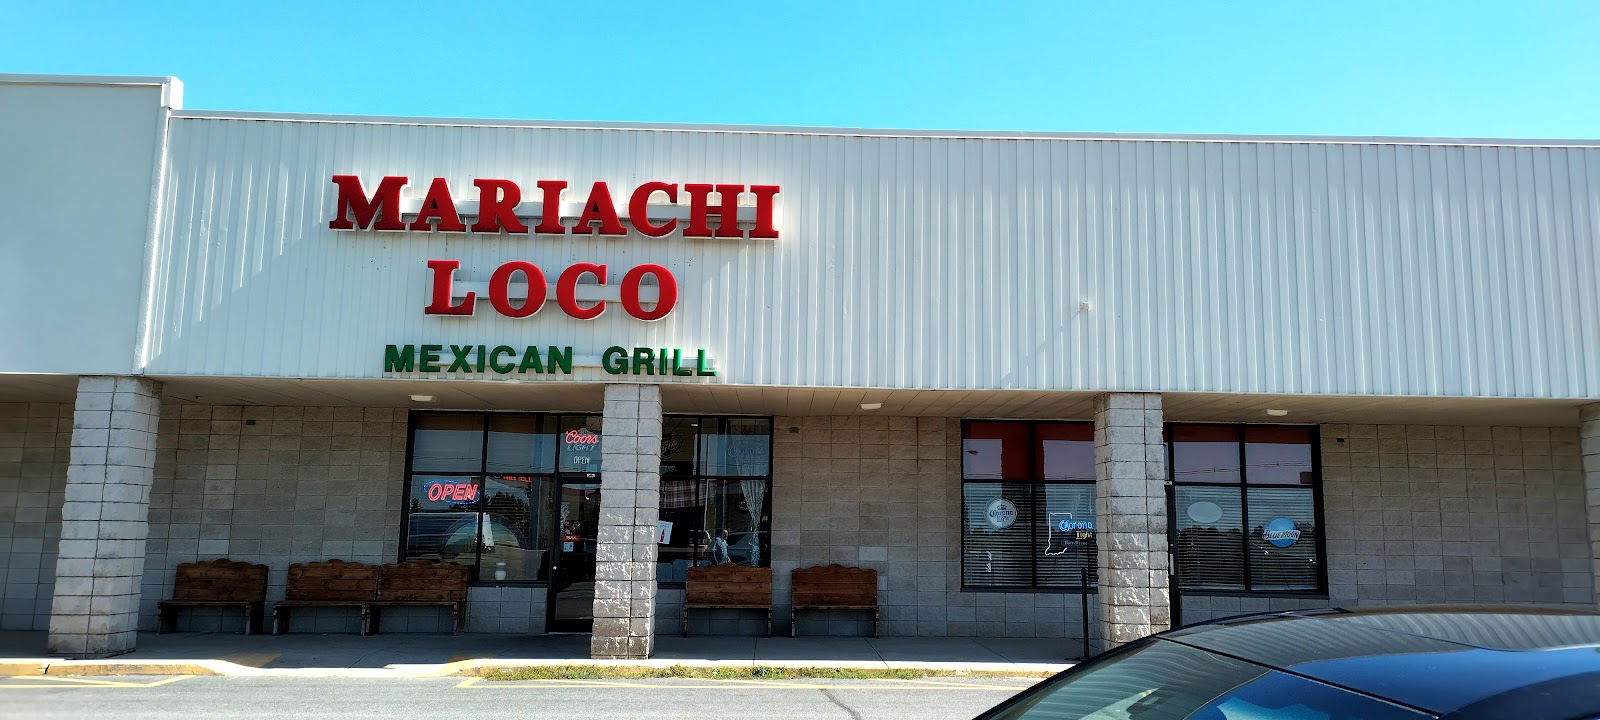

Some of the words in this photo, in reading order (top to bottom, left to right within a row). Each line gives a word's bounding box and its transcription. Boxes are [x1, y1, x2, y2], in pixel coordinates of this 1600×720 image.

[329, 174, 781, 240] MARIACHI
[424, 259, 679, 322] LOCO
[384, 344, 573, 375] MEXICAN
[601, 345, 718, 378] GRILL
[565, 429, 600, 445] Coors
[573, 455, 591, 465] OPEN
[427, 483, 479, 502] OPEN
[1058, 519, 1094, 532] Corona
[1075, 530, 1093, 541] Light
[1281, 530, 1300, 540] MOON
